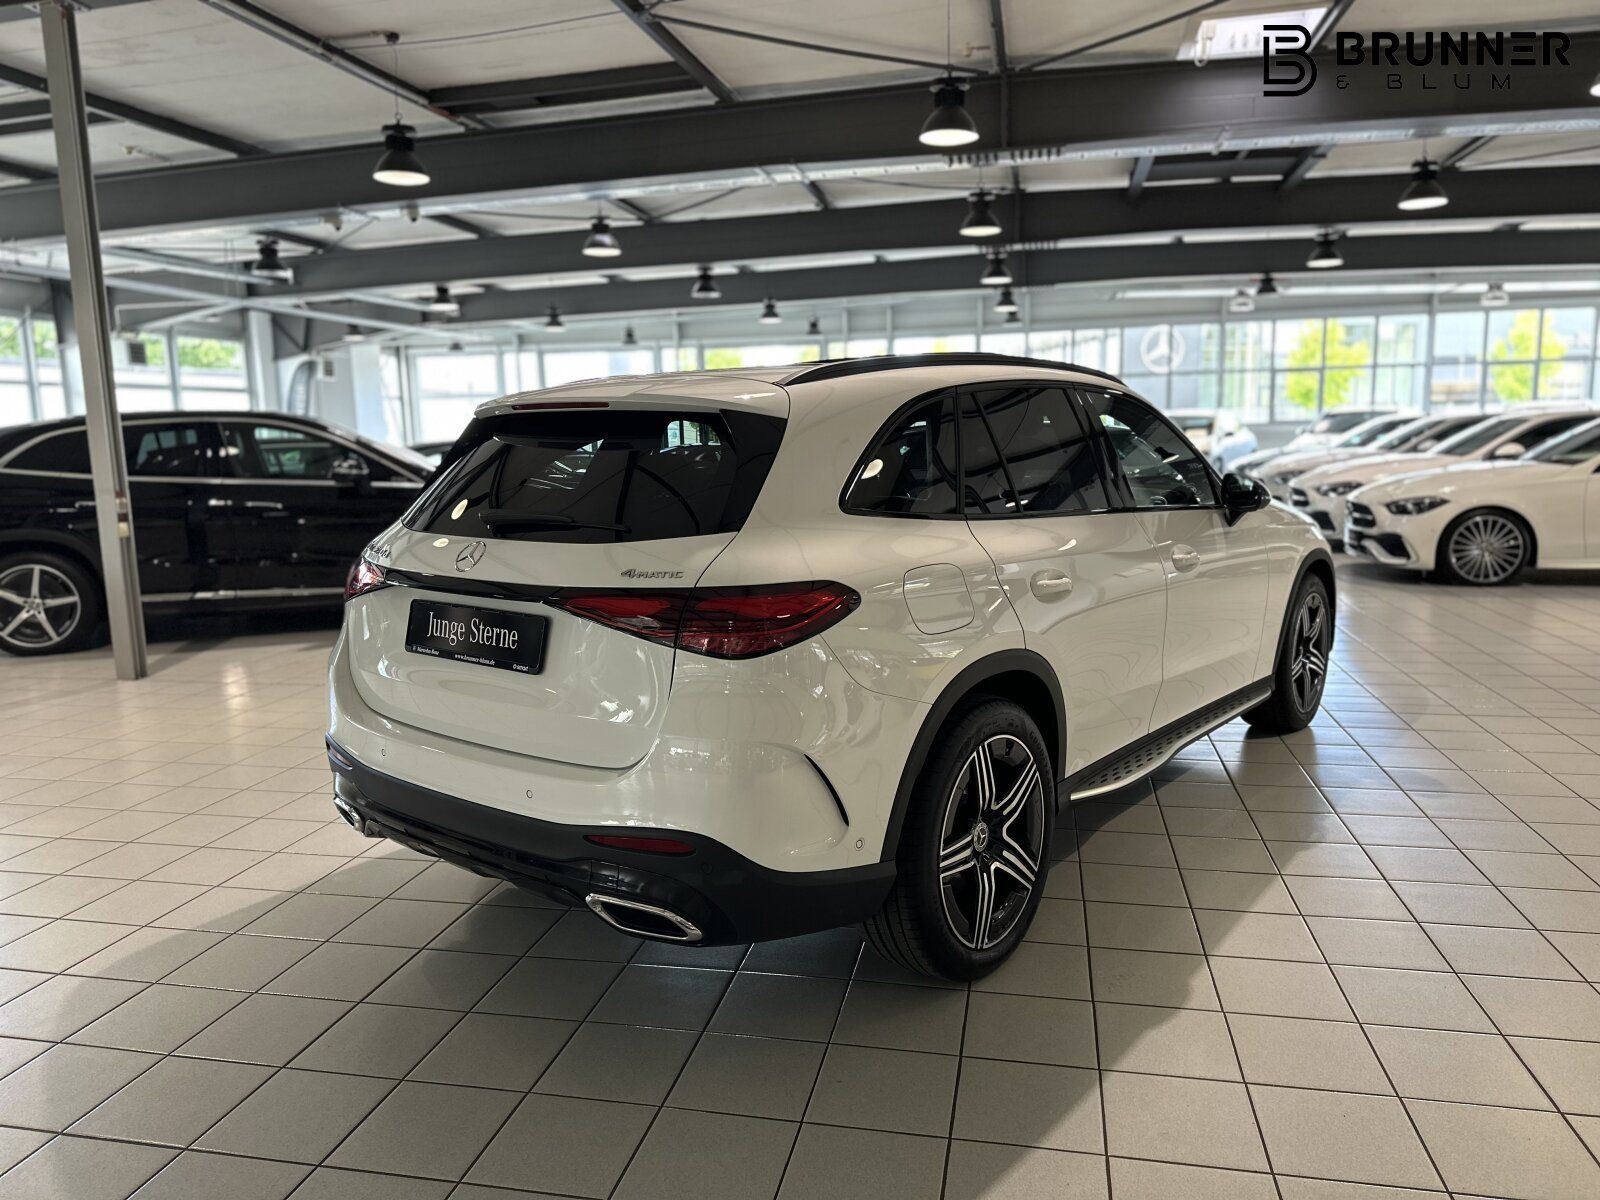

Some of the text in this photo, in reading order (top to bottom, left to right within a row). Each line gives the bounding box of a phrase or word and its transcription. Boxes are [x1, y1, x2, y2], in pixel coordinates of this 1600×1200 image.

[620, 568, 684, 579] 4MATIC
[427, 611, 519, 650] Junge Sterne
